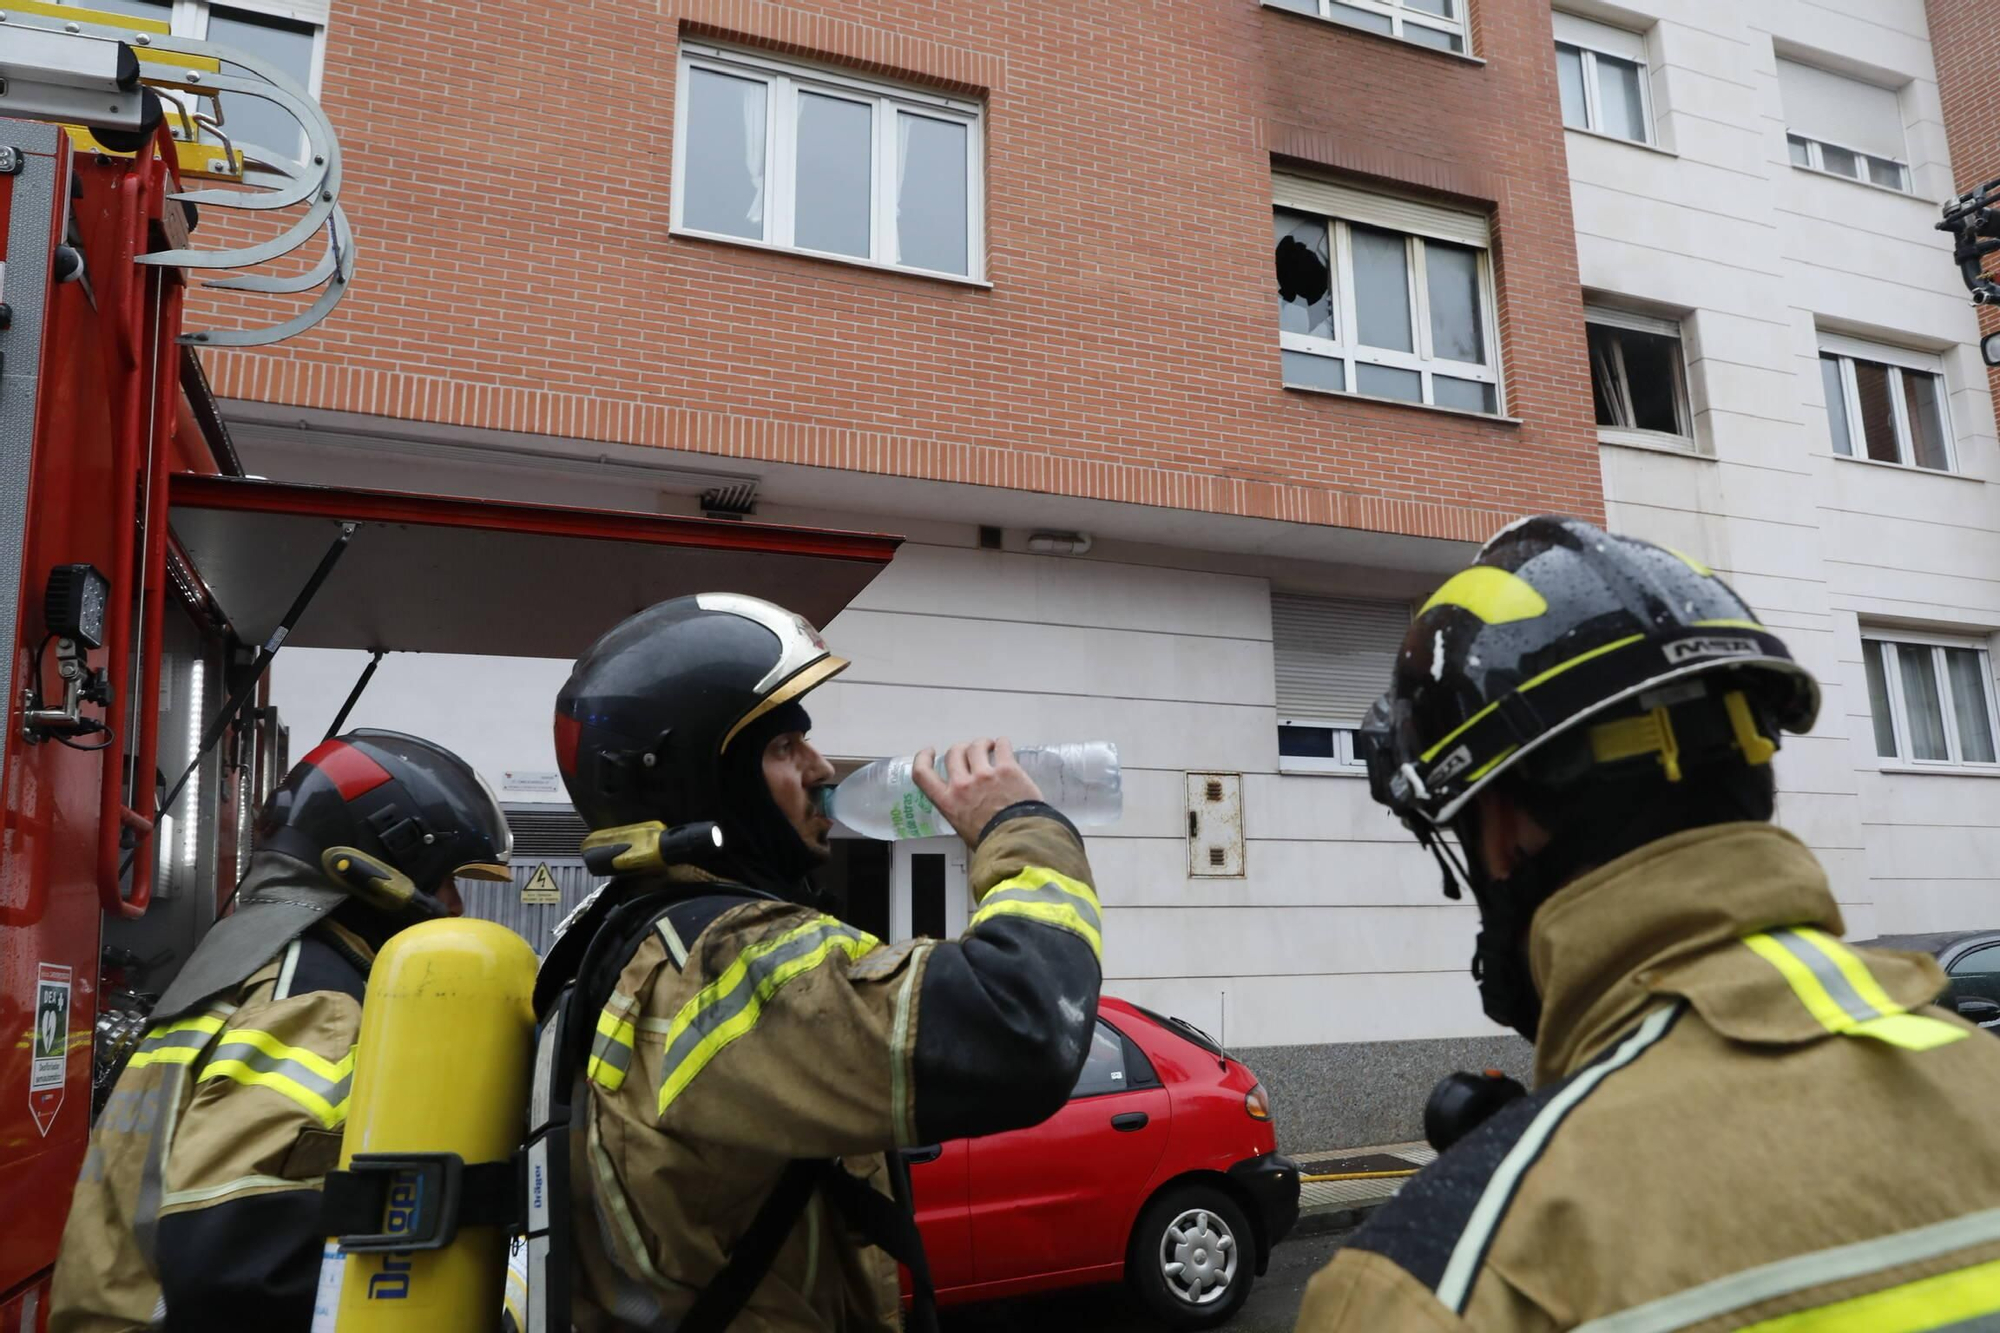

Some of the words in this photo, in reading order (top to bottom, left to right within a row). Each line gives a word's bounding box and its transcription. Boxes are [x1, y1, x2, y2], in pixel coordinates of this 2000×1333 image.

[1674, 640, 1754, 657] MSA
[44, 990, 57, 1004] DEA
[533, 1165, 543, 1209] Dräger
[368, 1171, 418, 1300] Drger
